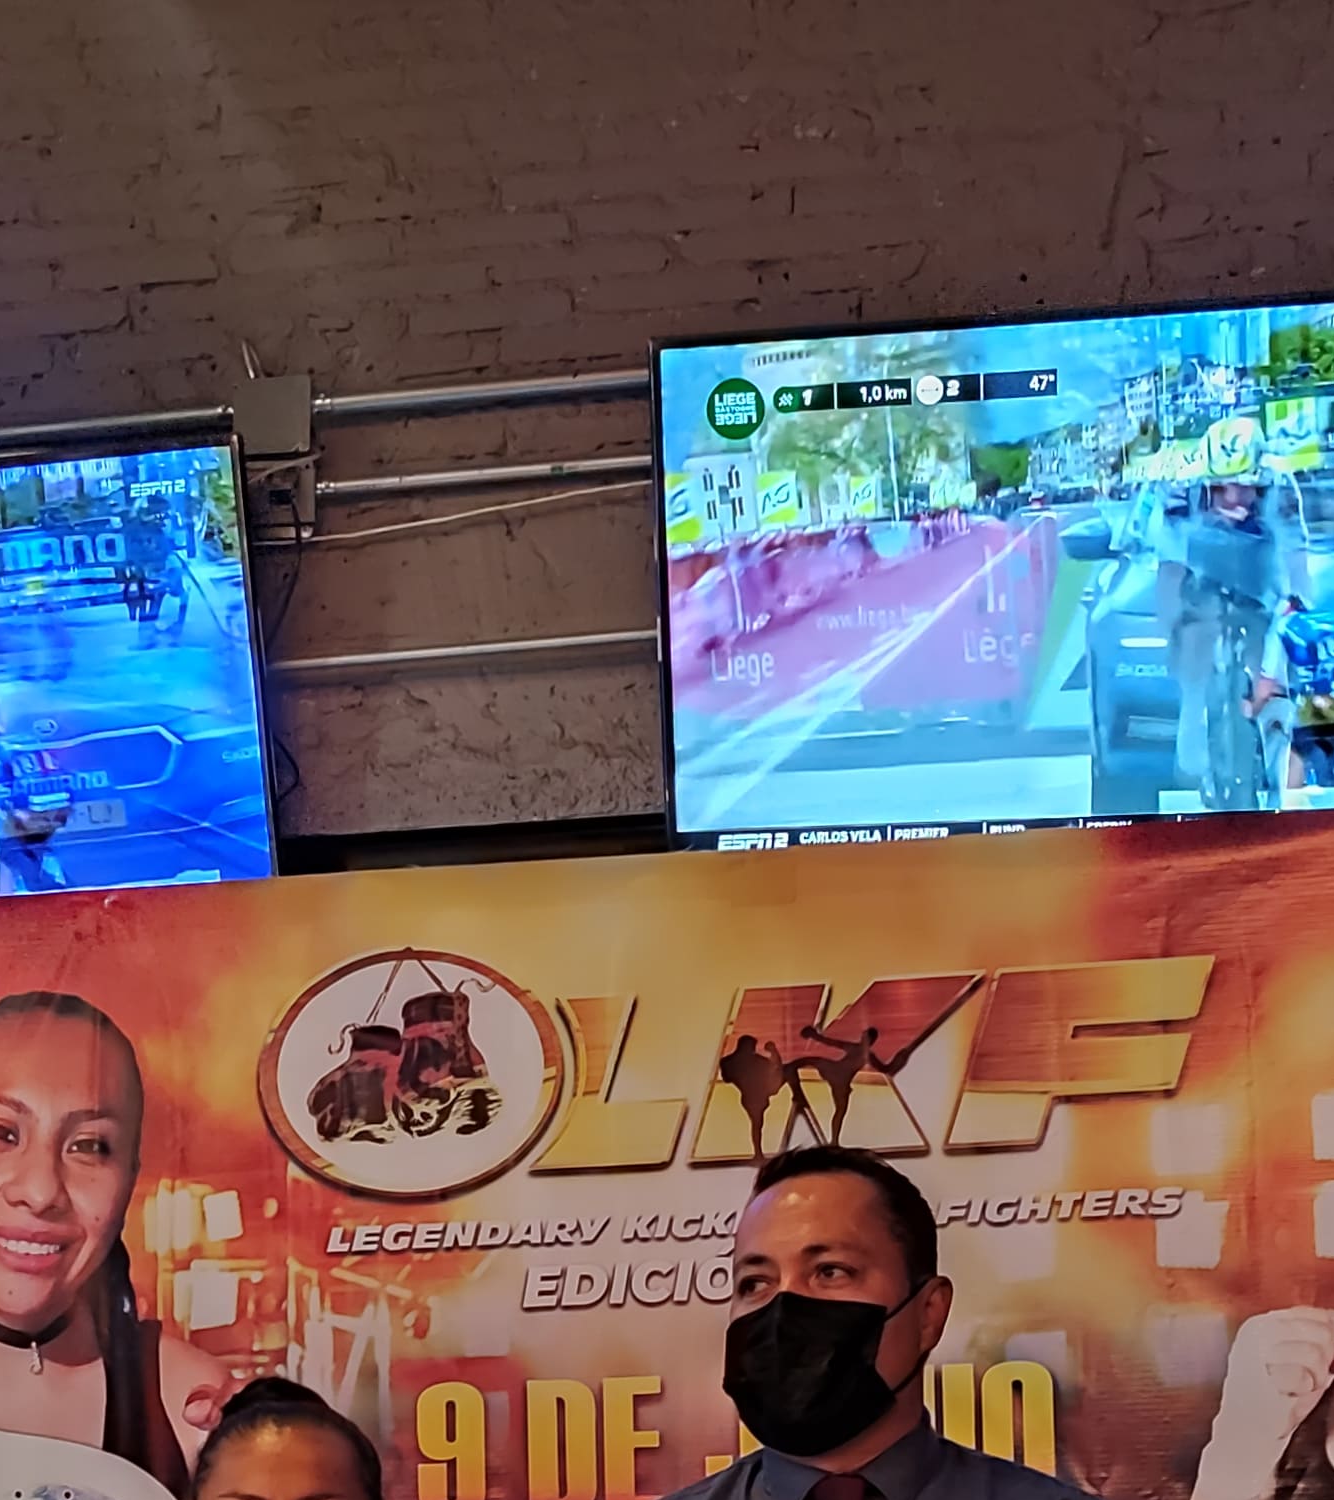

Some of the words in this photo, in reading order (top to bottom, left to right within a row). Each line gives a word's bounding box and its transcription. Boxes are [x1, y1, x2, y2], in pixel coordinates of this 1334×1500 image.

[714, 392, 756, 406] LIEGE
[885, 386, 907, 401] km
[799, 830, 849, 845] CARLOS
[849, 829, 882, 842] VELA
[325, 1214, 608, 1257] LEGENDARY
[933, 1187, 1185, 1228] FIGHTERS
